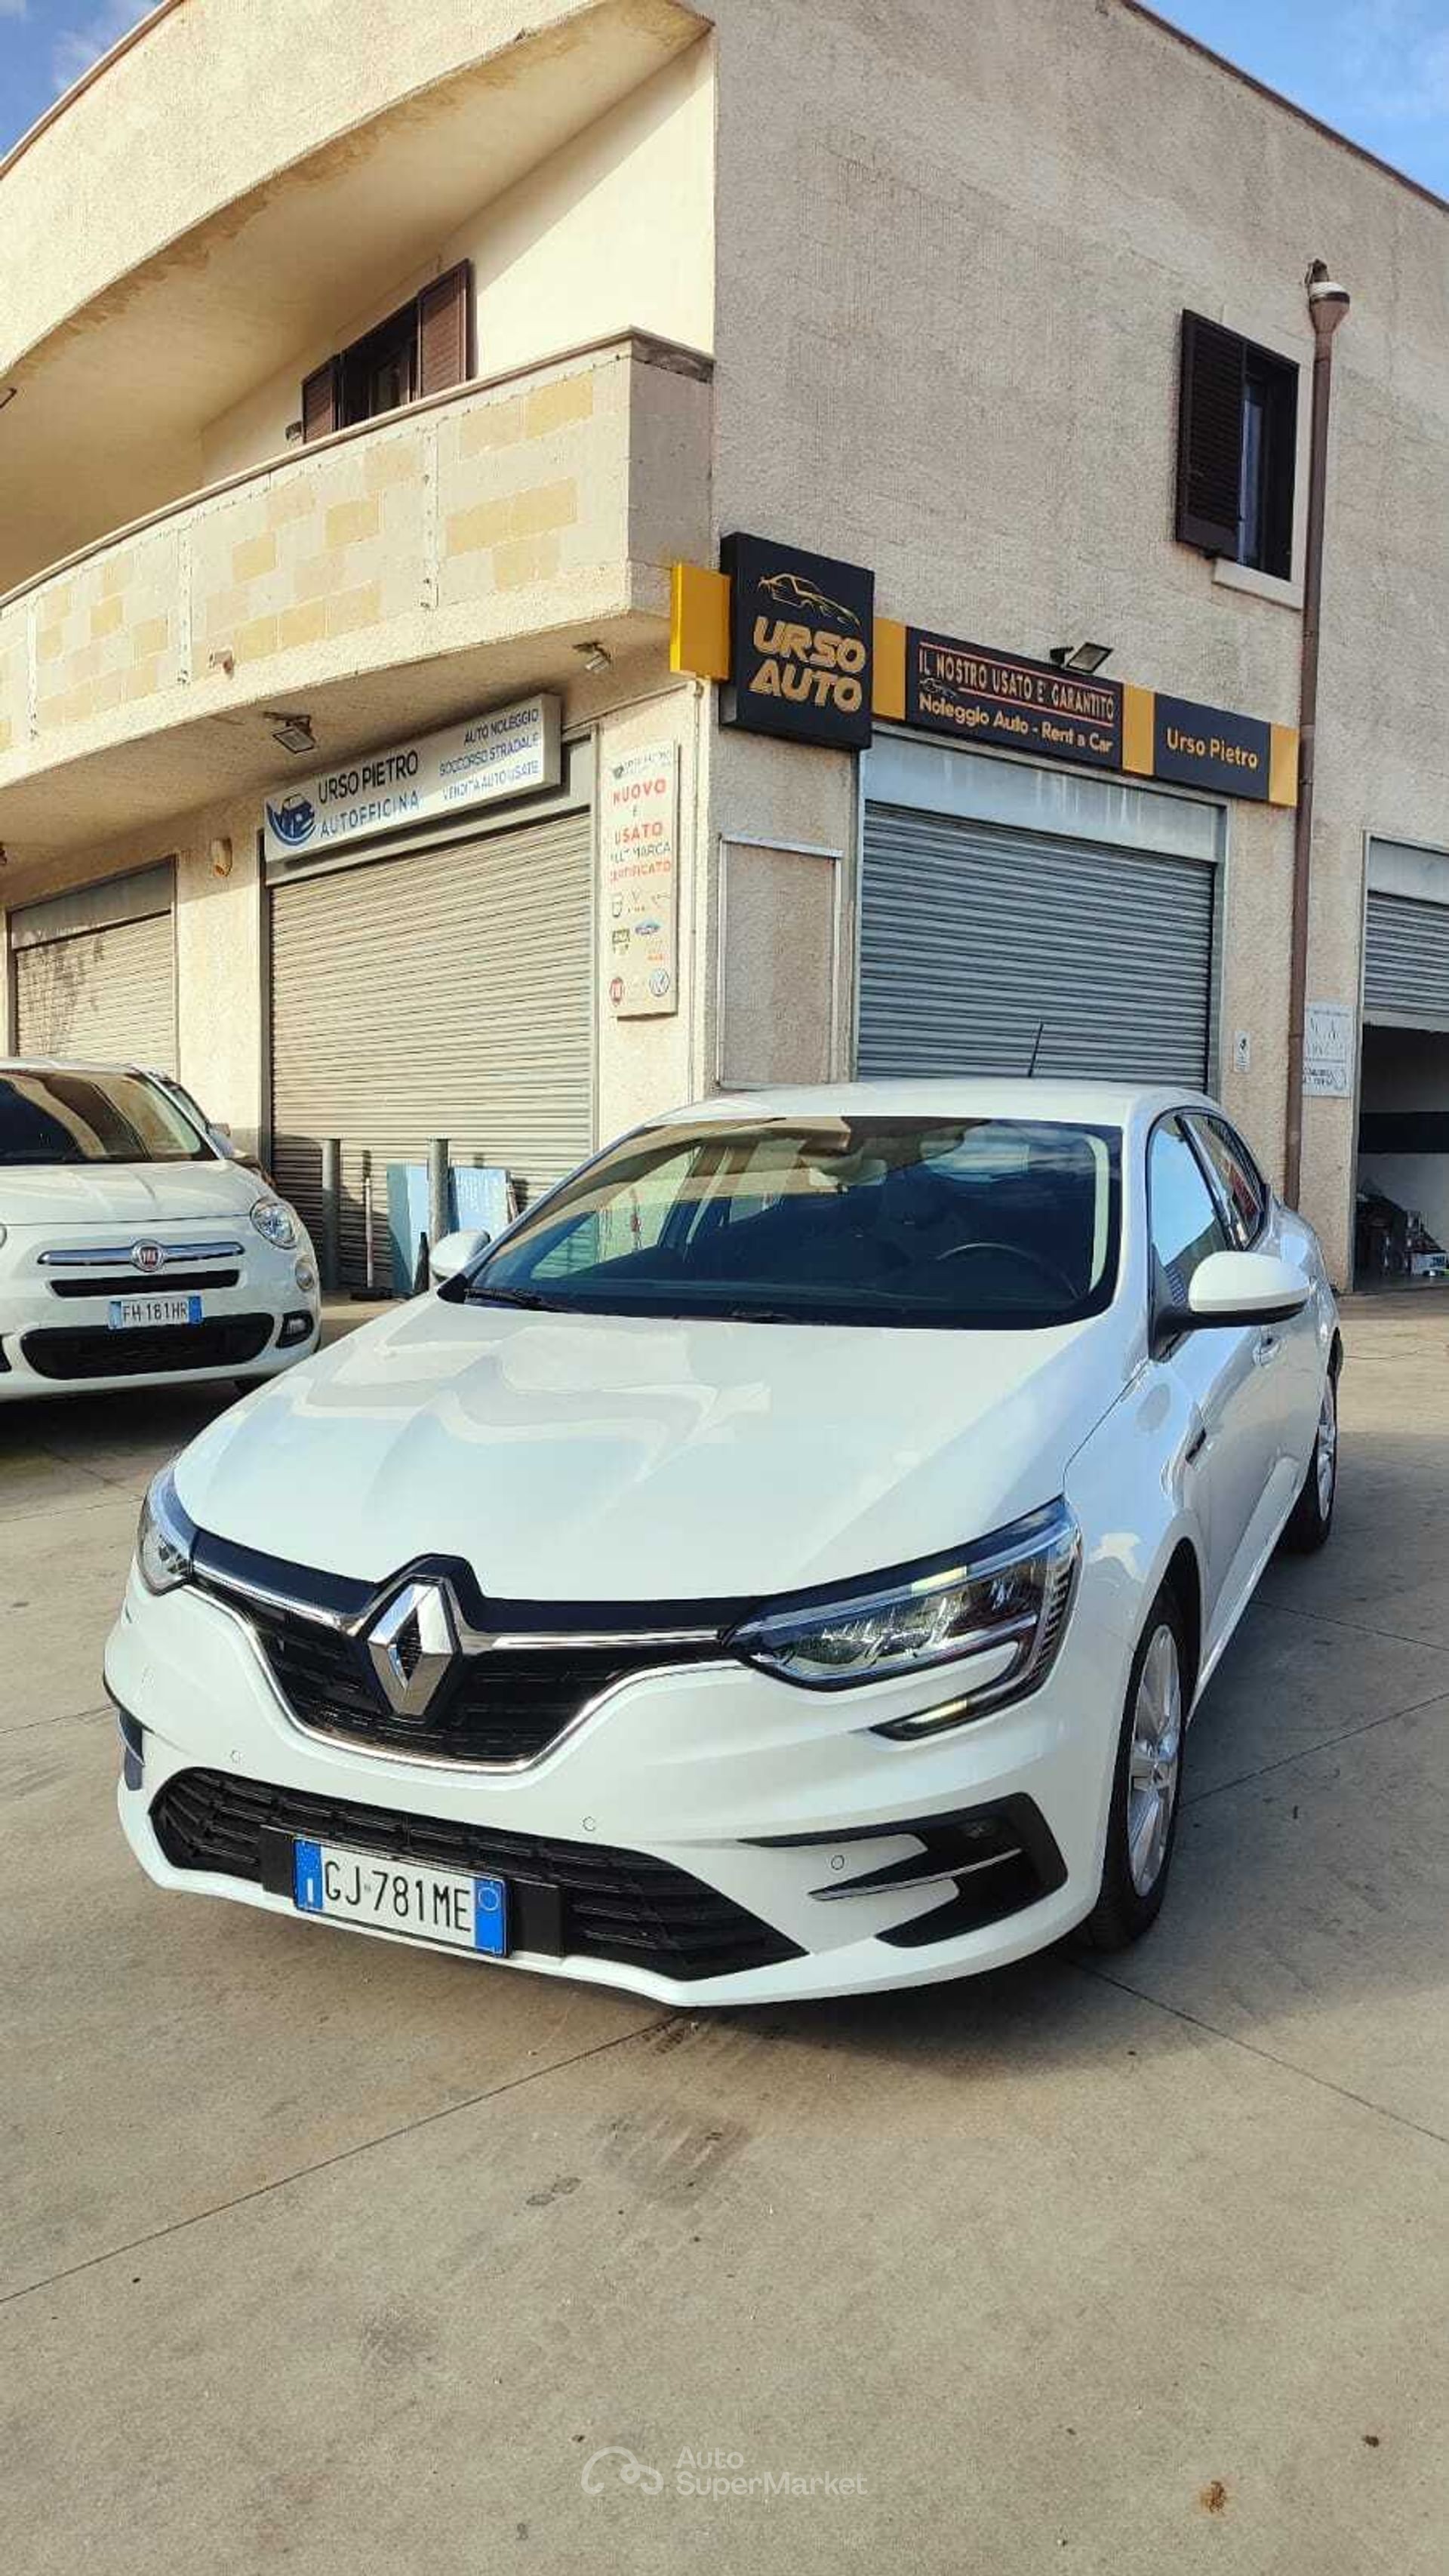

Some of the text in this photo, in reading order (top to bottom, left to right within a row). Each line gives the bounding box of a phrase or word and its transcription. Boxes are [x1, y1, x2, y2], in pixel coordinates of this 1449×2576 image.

[753, 616, 866, 673] URSO
[748, 659, 862, 712] AUTO
[918, 648, 931, 675] IL
[936, 653, 987, 688] NOSTRO
[992, 668, 1032, 700] USATO
[1051, 683, 1114, 719] GARANTITO
[463, 708, 539, 746] AUTO NOLEGGIO
[918, 693, 989, 726] Noleggio
[993, 710, 1029, 734] Auto
[1041, 722, 1074, 744] Rent
[1089, 733, 1113, 752] Car
[439, 731, 539, 777] SOCCORSO STRADALE
[1167, 727, 1258, 769] Urso Pietro
[318, 749, 418, 804] URSO PIETRO
[481, 771, 506, 790] AUTO
[613, 778, 666, 805] NUOVO
[320, 790, 420, 838] AUTOFFICINA
[615, 822, 663, 845] USATO
